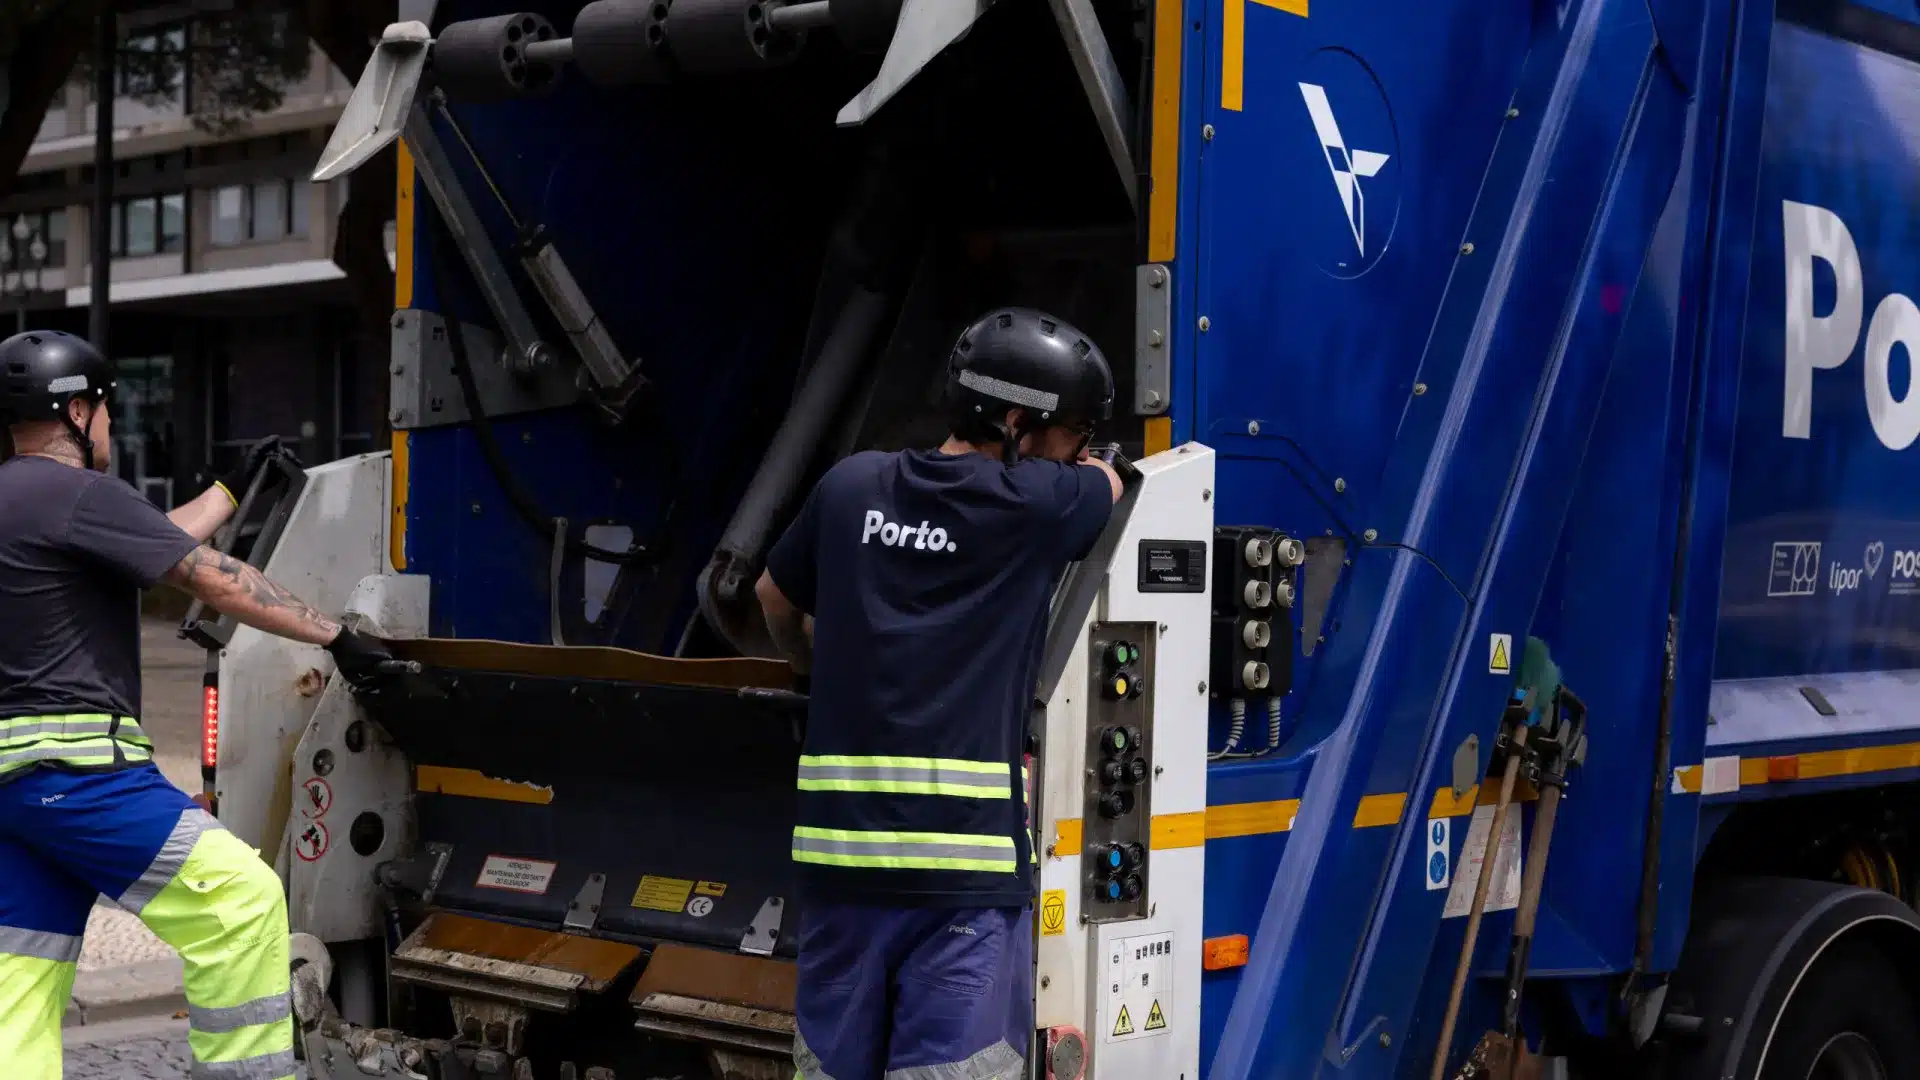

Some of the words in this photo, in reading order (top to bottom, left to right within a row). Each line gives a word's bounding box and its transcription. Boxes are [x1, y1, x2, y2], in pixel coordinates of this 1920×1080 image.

[1783, 199, 1920, 451] Po
[861, 509, 957, 553] Porto.
[1829, 561, 1863, 596] lipor
